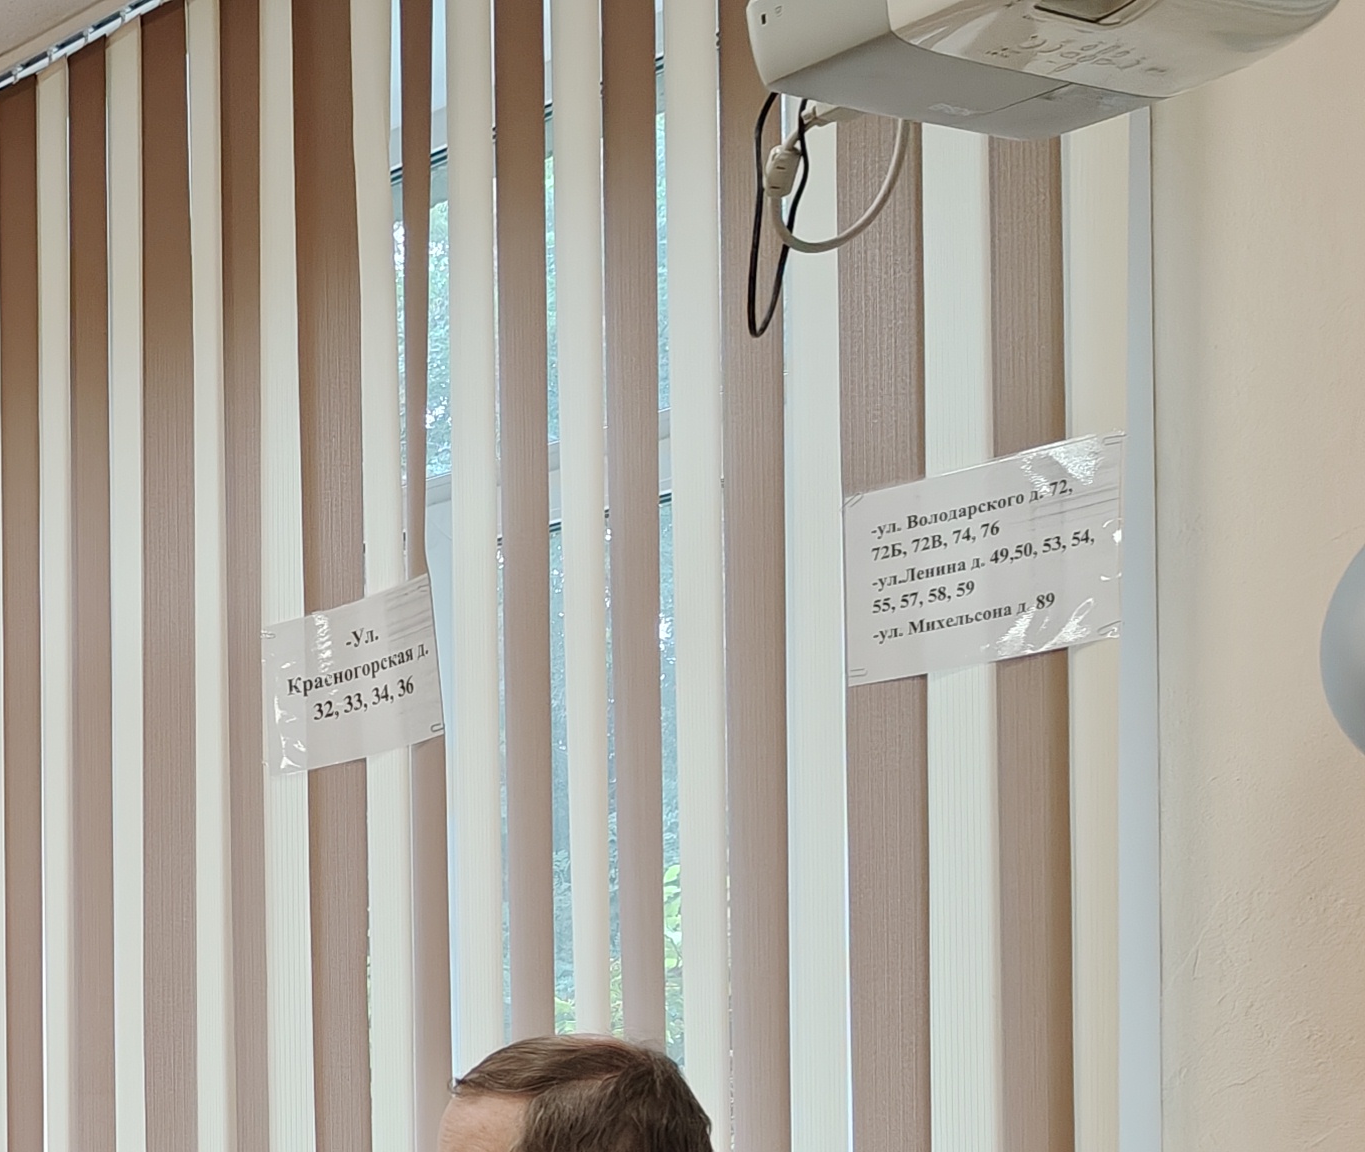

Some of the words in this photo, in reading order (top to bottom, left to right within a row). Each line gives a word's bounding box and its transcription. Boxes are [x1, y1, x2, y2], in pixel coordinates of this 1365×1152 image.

[871, 522, 901, 539] -ул.
[906, 494, 1024, 530] Володарского
[1028, 490, 1044, 503] д.
[1049, 479, 1073, 497] 72,
[871, 543, 907, 561] 72Б,
[911, 534, 947, 553] 72В,
[952, 527, 976, 544] 74,
[980, 520, 1000, 538] 76
[872, 560, 966, 591] -ул.Ленина
[970, 557, 985, 570] д.
[990, 542, 1038, 564] 49,50,
[1042, 536, 1066, 554] 53,
[1071, 529, 1095, 547] 54,
[872, 597, 896, 614] 55,
[900, 592, 923, 608] 57,
[928, 586, 951, 603] 58,
[956, 580, 975, 598] 59
[873, 628, 903, 644] -ул.
[908, 605, 1012, 635] Михельсона
[1036, 592, 1055, 610] 89
[346, 627, 379, 647] -Ул.
[287, 648, 413, 696] Красногорская
[417, 644, 429, 659] д.
[313, 700, 339, 720] 32,
[343, 692, 368, 713] 33,
[371, 684, 394, 704] 34,
[397, 675, 414, 697] 36
